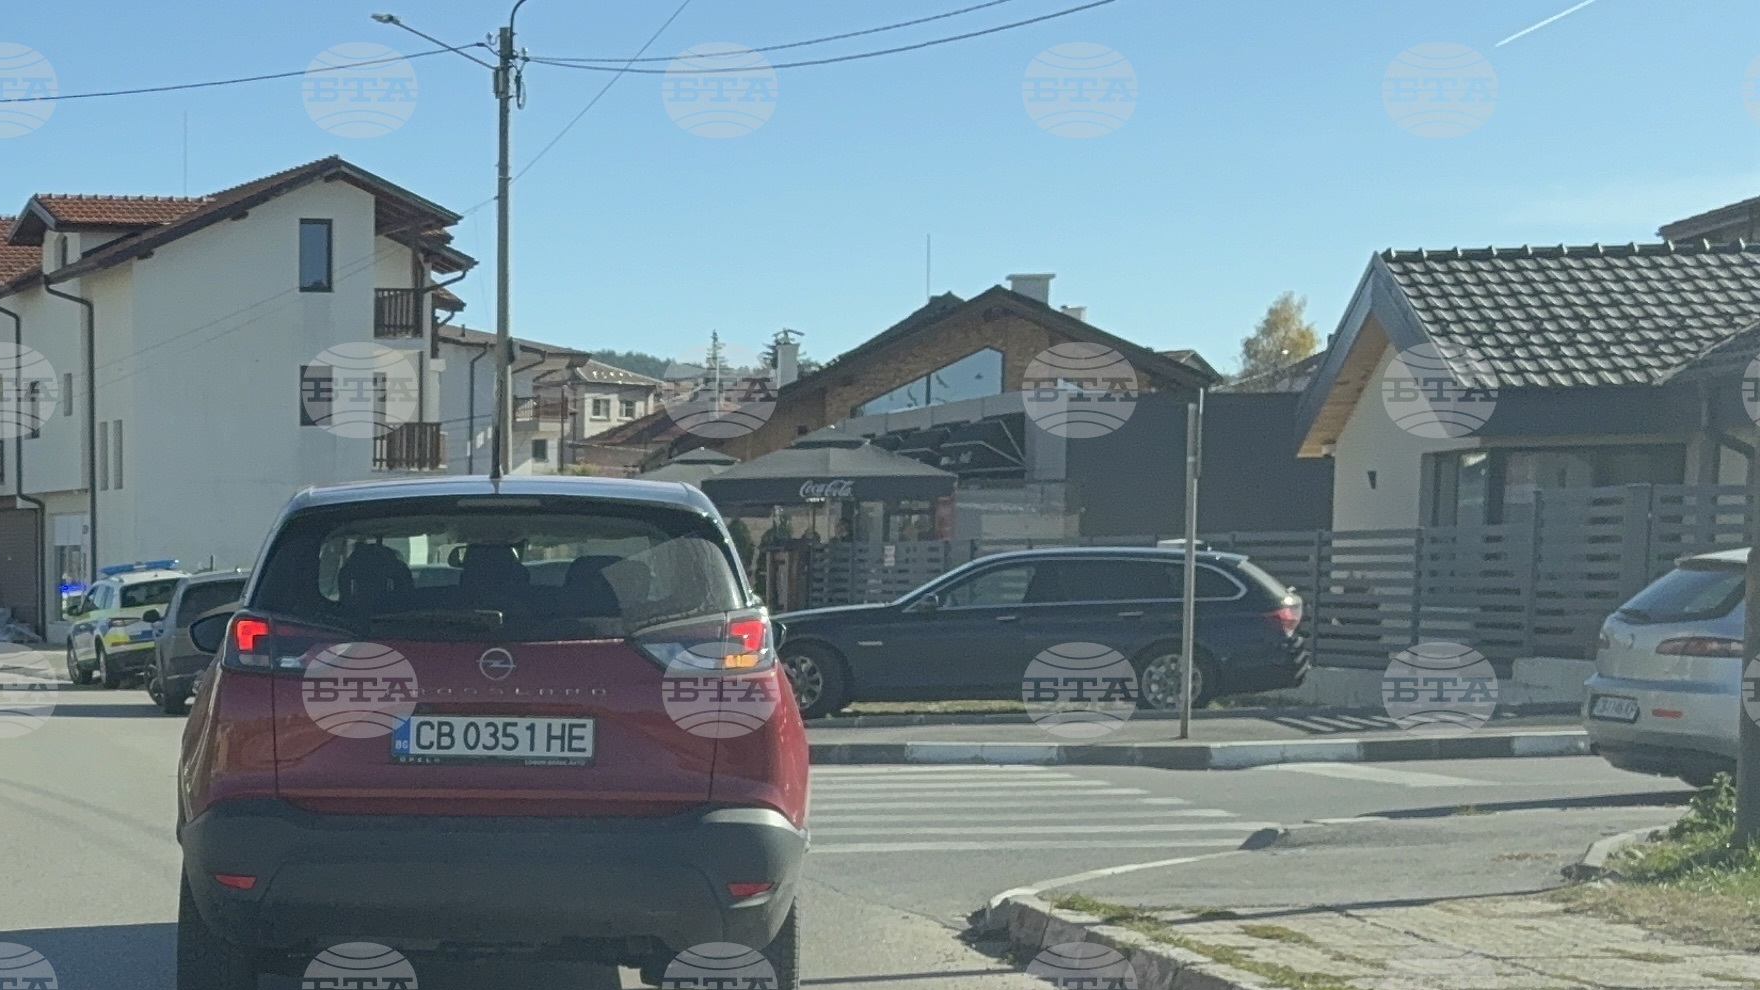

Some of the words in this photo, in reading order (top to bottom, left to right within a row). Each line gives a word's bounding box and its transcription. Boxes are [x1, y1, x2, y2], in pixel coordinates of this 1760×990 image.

[395, 739, 408, 750] BG
[415, 720, 456, 751] CB
[463, 721, 537, 752] 0351
[545, 722, 587, 753] HE
